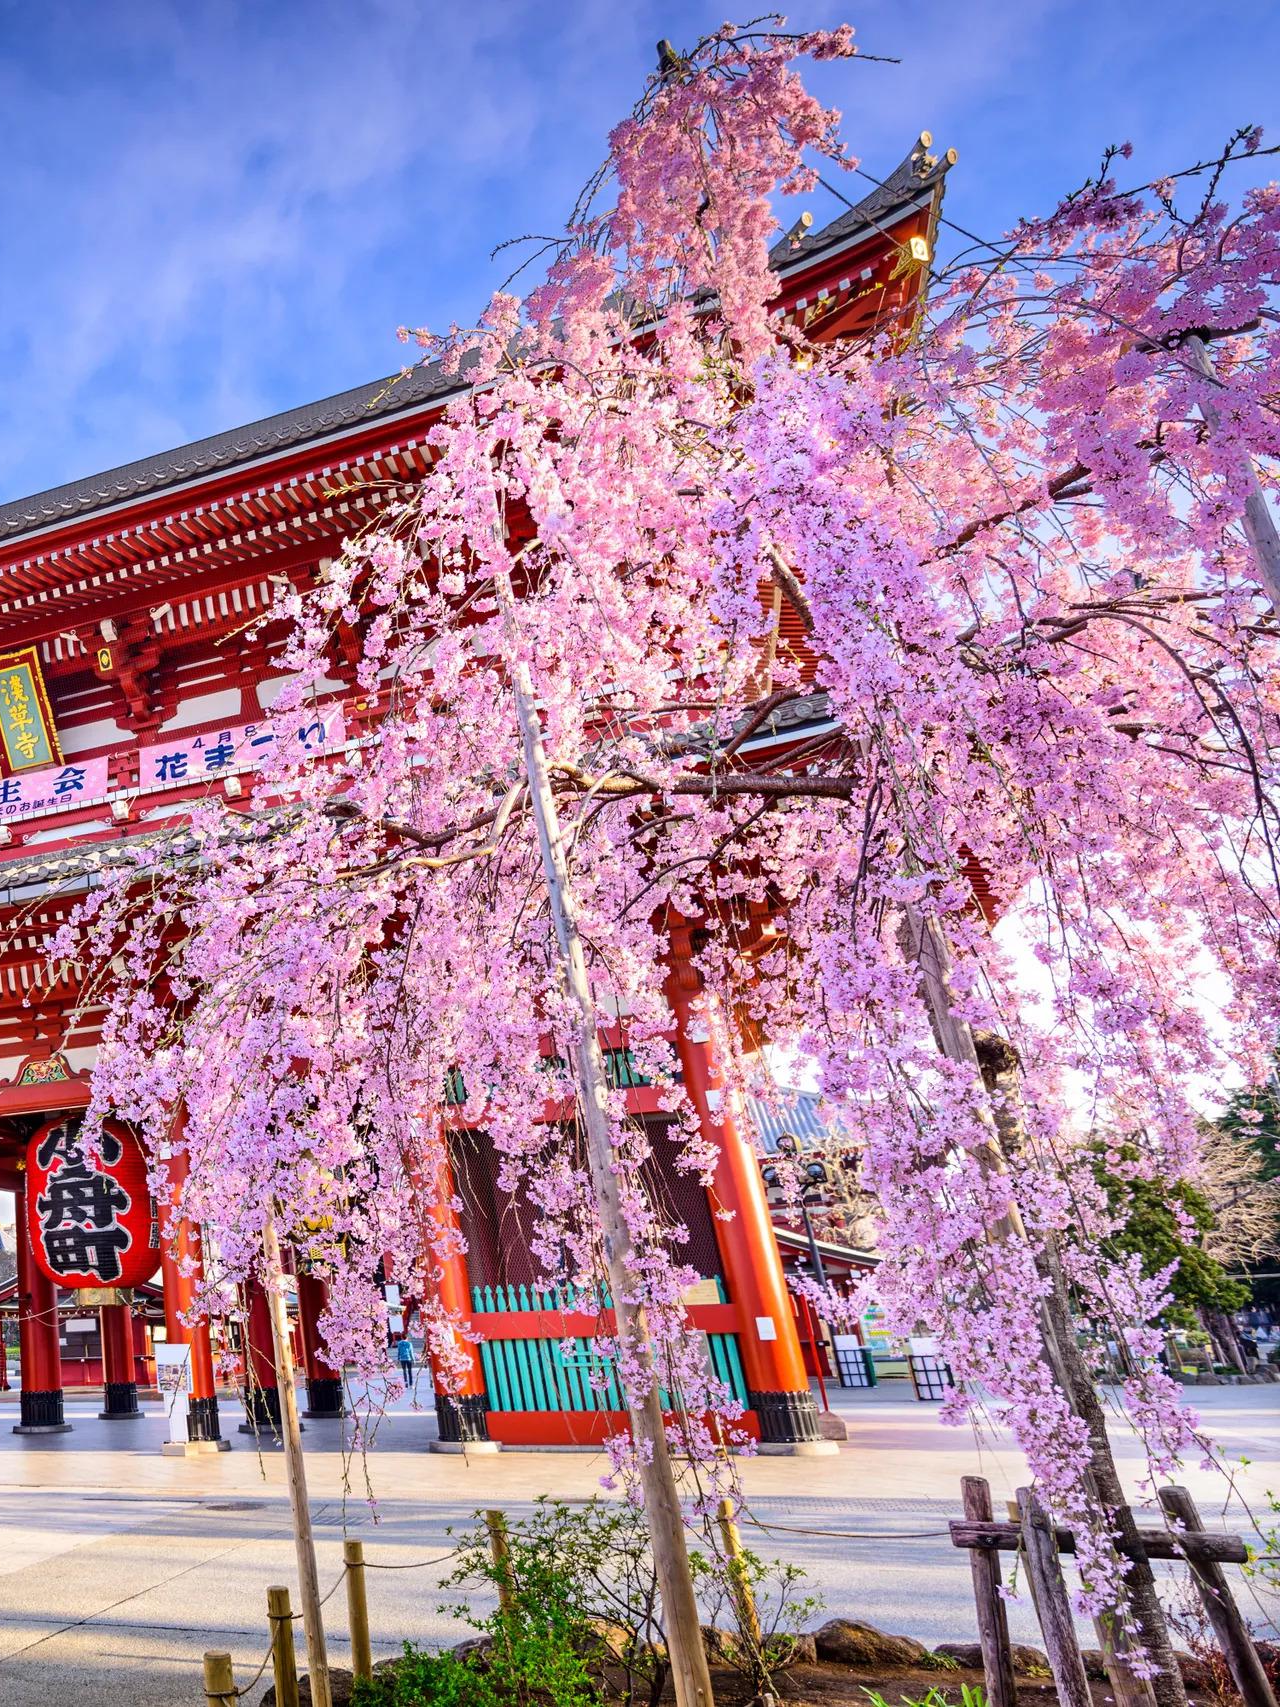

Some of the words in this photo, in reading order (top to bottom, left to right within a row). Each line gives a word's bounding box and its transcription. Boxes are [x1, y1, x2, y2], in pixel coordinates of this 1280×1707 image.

[191, 725, 258, 749] 4月8
[36, 1118, 133, 1283] 小舟町
